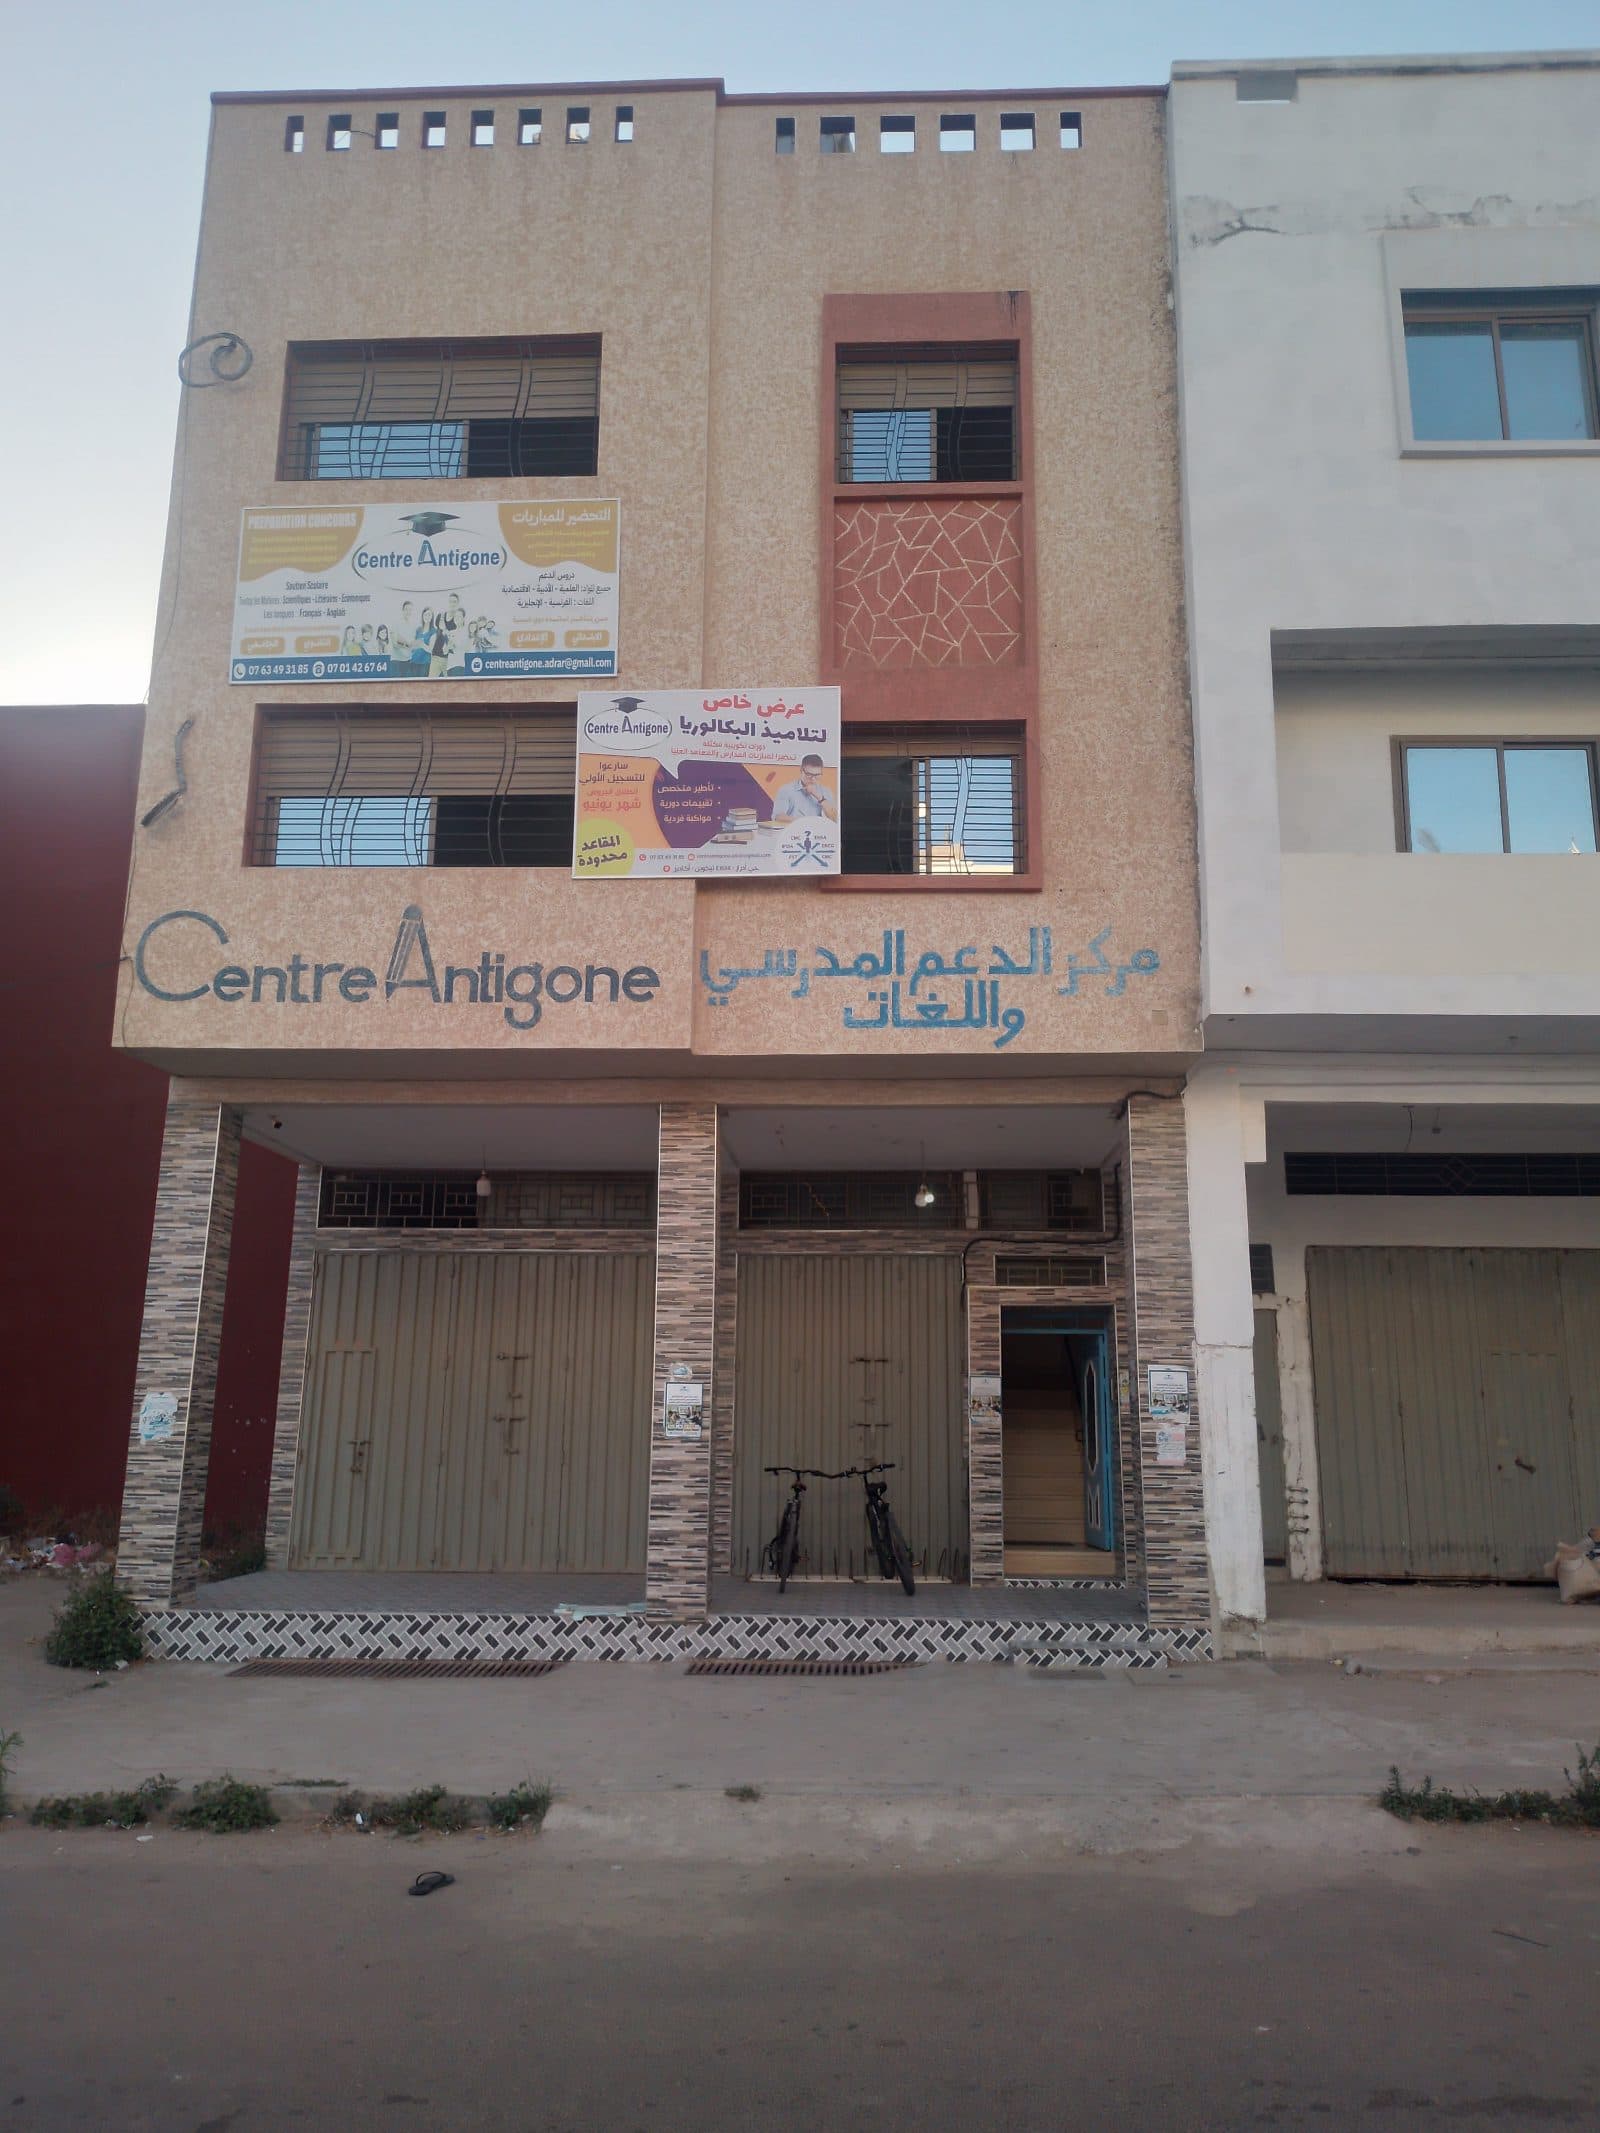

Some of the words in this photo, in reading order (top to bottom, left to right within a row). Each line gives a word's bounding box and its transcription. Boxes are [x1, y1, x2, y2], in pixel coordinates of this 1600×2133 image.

[512, 507, 564, 526] للمباريات
[564, 507, 611, 527] التحضير
[357, 551, 413, 569] Centre
[418, 540, 501, 570] Antigone
[248, 666, 259, 675] 07
[260, 665, 272, 675] 63
[272, 665, 285, 675] 49
[285, 664, 298, 675] 31
[327, 664, 338, 673] 07
[339, 663, 351, 673] 01
[351, 663, 363, 673] 42
[364, 663, 375, 672] 67
[376, 662, 388, 672] 64
[485, 657, 612, 670] centreantigone.adrar@gmail.com
[702, 693, 752, 712] خاص
[756, 697, 805, 719] عرض
[587, 722, 619, 734] Centre
[621, 715, 669, 737] Antigone
[679, 715, 756, 740] البكالوريا
[760, 720, 827, 743] لتلاميذ
[599, 761, 628, 770] سارعوا
[608, 773, 646, 784] للتسجيل
[693, 780, 715, 793] تأطير
[657, 785, 692, 794] متخصص
[581, 834, 621, 852] المقاعد
[577, 851, 628, 868] محدودة
[135, 909, 378, 1004] Centre
[385, 903, 661, 1031] Antigone
[699, 929, 906, 1006] المدرسي
[908, 926, 1053, 997] الدعم
[1057, 926, 1161, 998] مركز
[842, 980, 1027, 1049] واللغات
